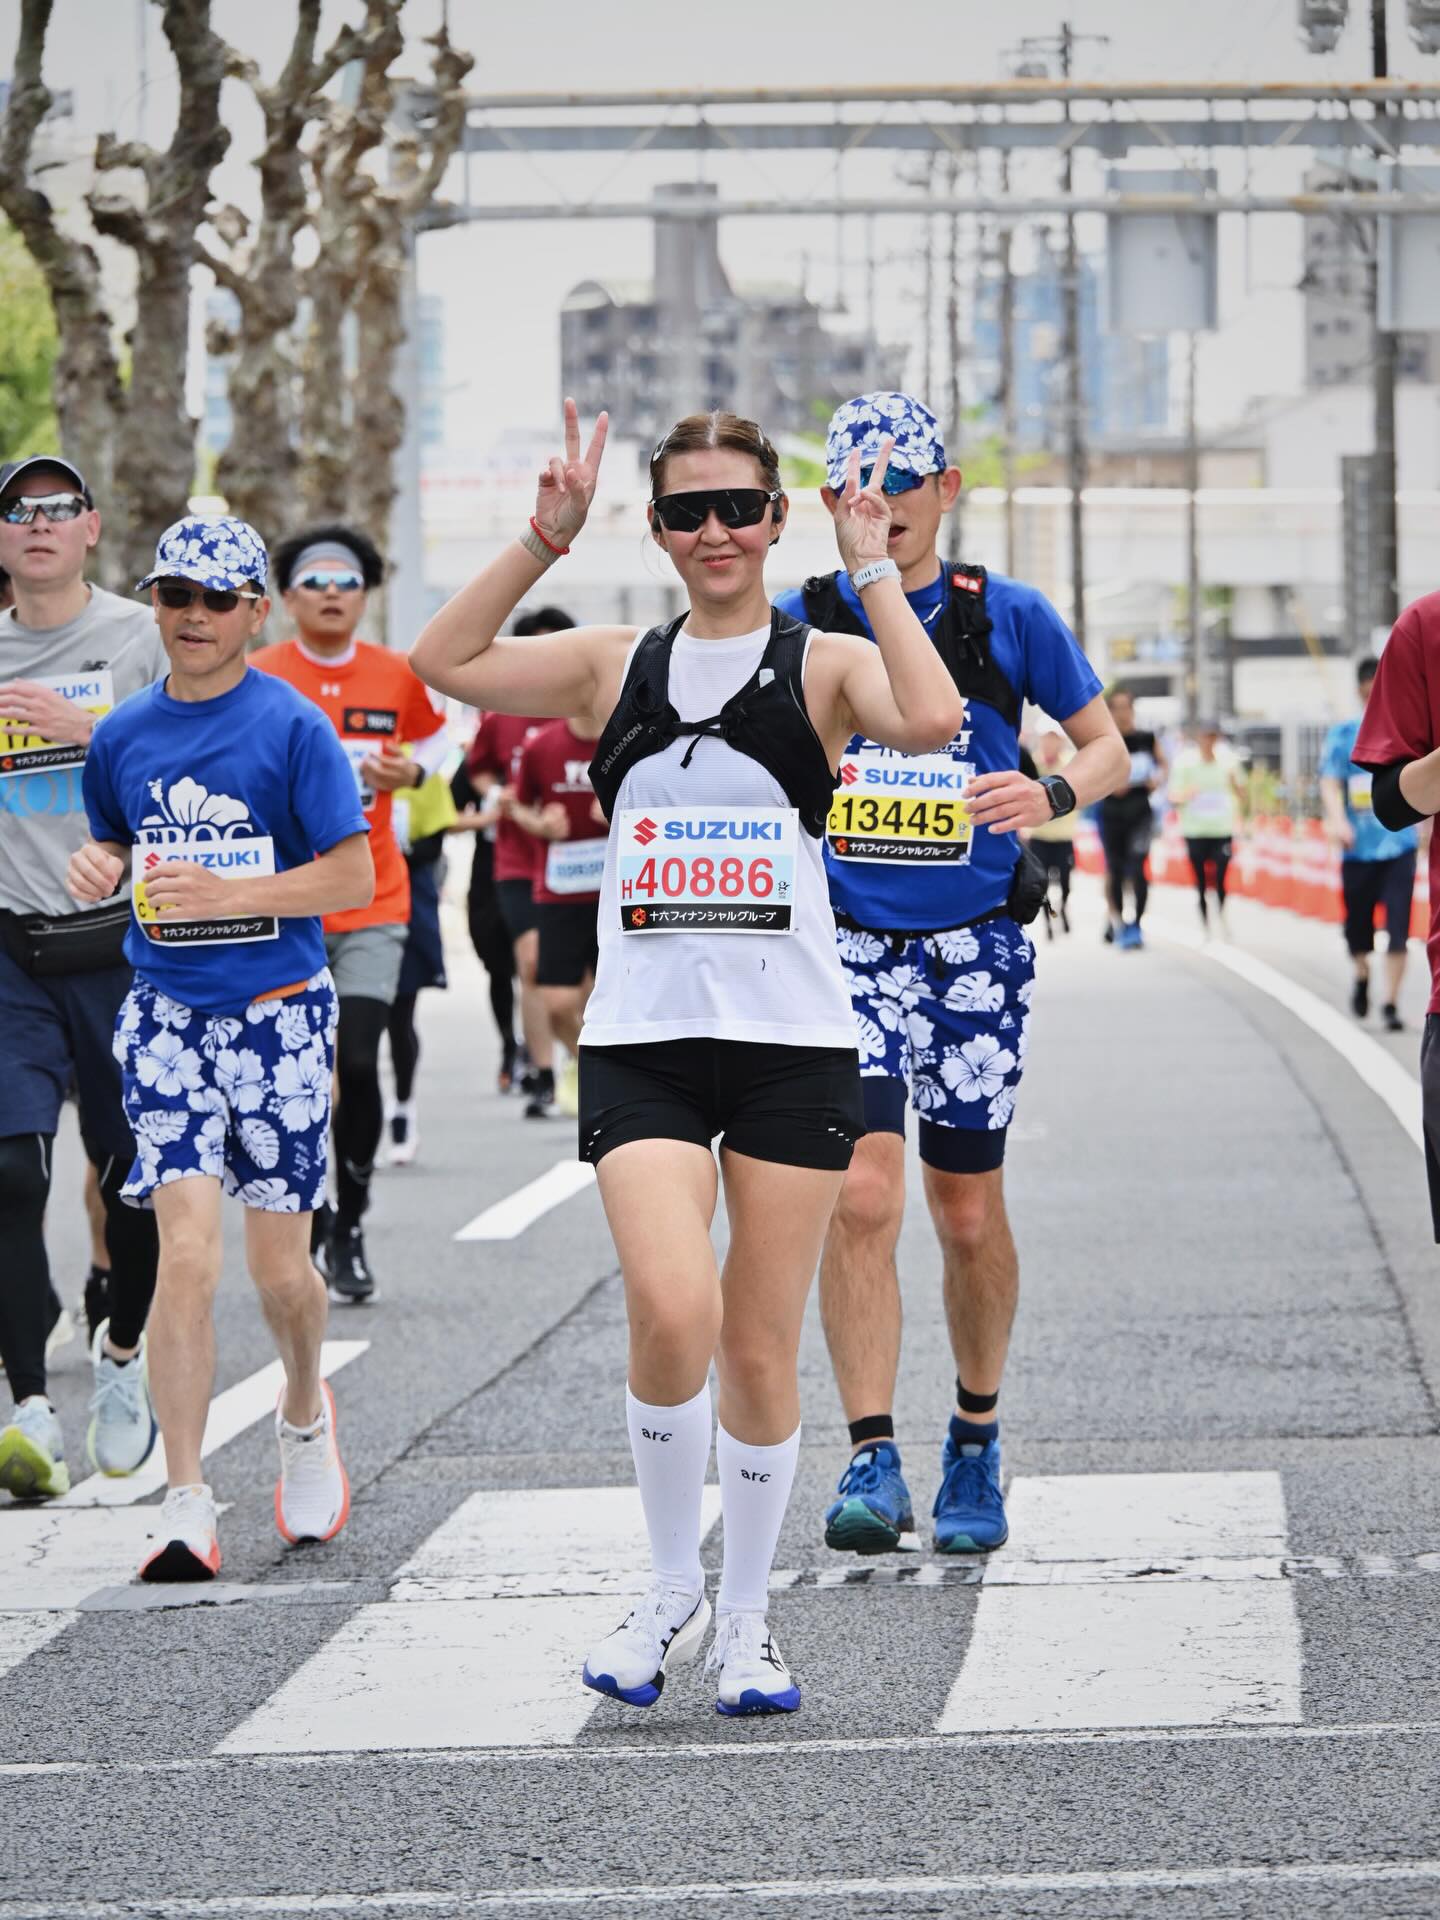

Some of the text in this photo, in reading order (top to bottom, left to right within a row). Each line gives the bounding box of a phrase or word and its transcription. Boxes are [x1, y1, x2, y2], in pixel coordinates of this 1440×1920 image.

[54, 684, 100, 699] UKI
[600, 722, 643, 775] SALOMON
[864, 768, 962, 789] SUZUKI
[664, 821, 782, 841] SUZUKI
[850, 842, 956, 857] 十六フィナンシャルグループ
[650, 910, 777, 922] 十六フィナンシャルグループ
[162, 922, 264, 938] 十六フィナンシャルグループ
[641, 1428, 673, 1442] arc
[740, 1469, 771, 1483] arc
